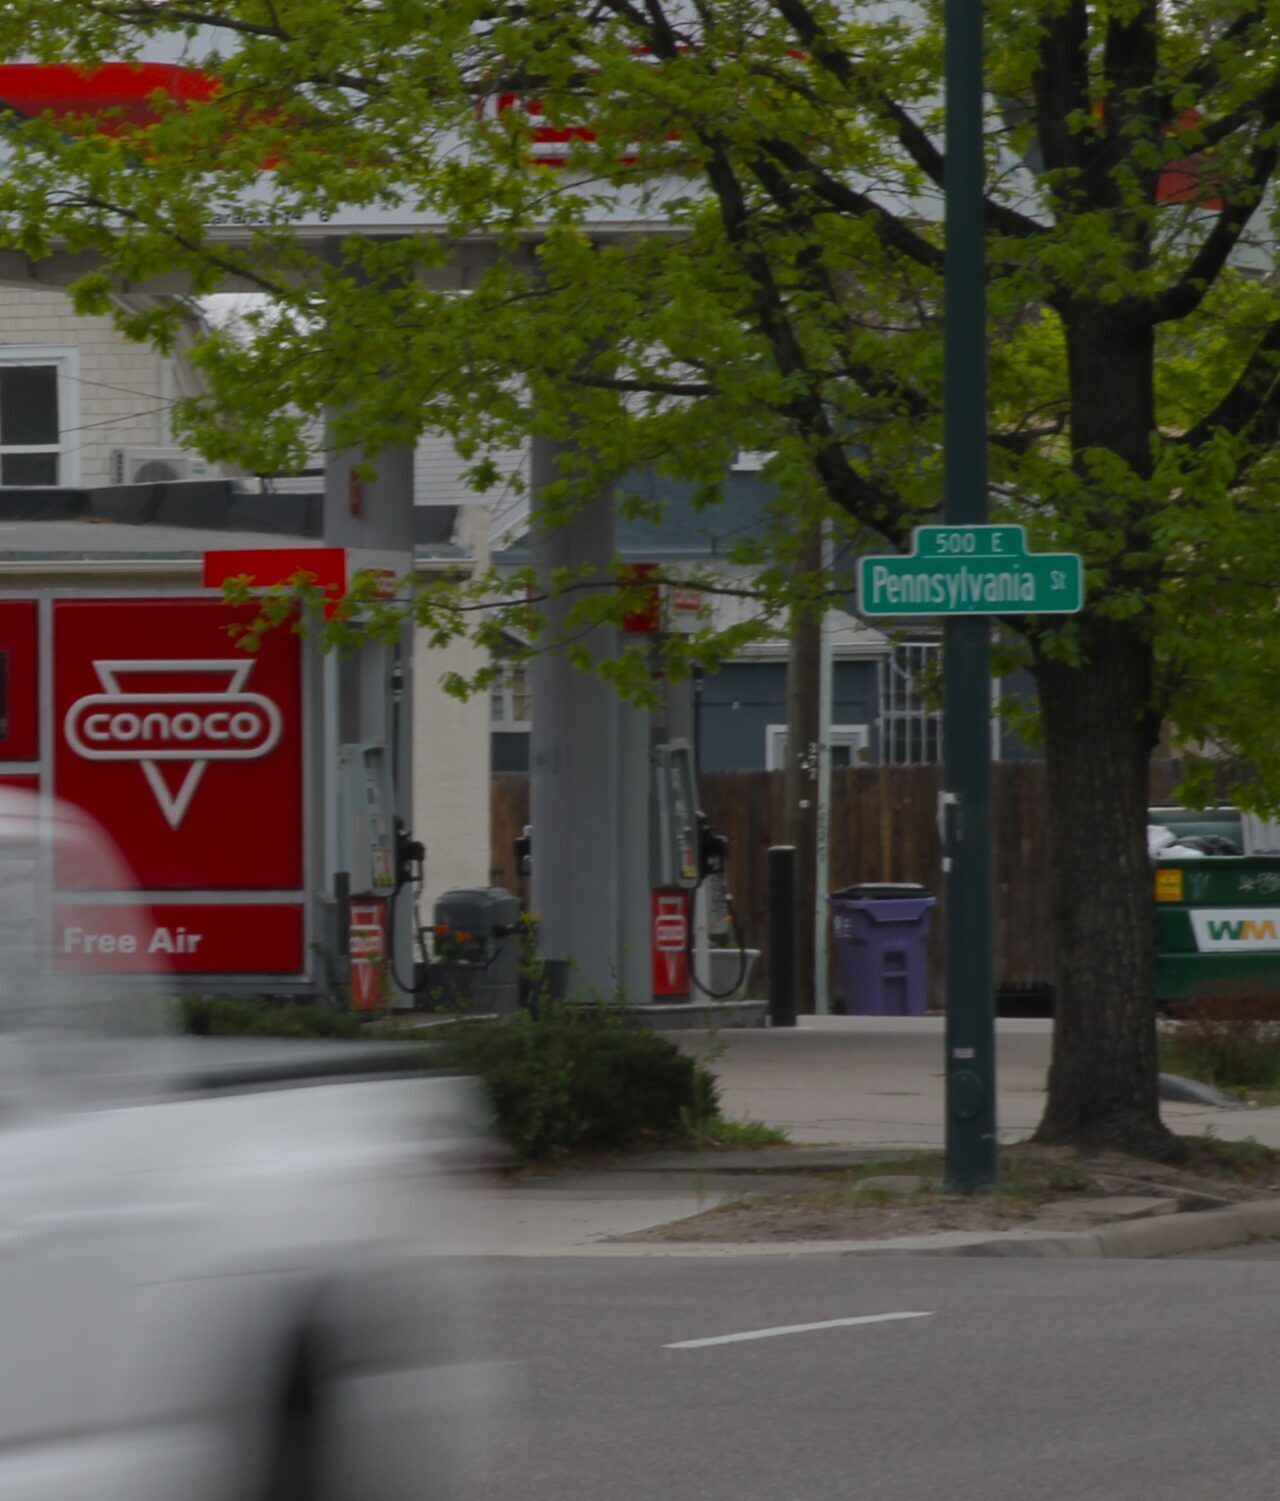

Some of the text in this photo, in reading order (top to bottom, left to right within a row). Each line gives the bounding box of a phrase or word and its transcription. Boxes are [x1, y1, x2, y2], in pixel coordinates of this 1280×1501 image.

[936, 532, 1004, 553] 500 E
[872, 564, 1035, 609] Pennsylvania
[63, 926, 203, 953] Free Air
[1206, 920, 1278, 941] WM
